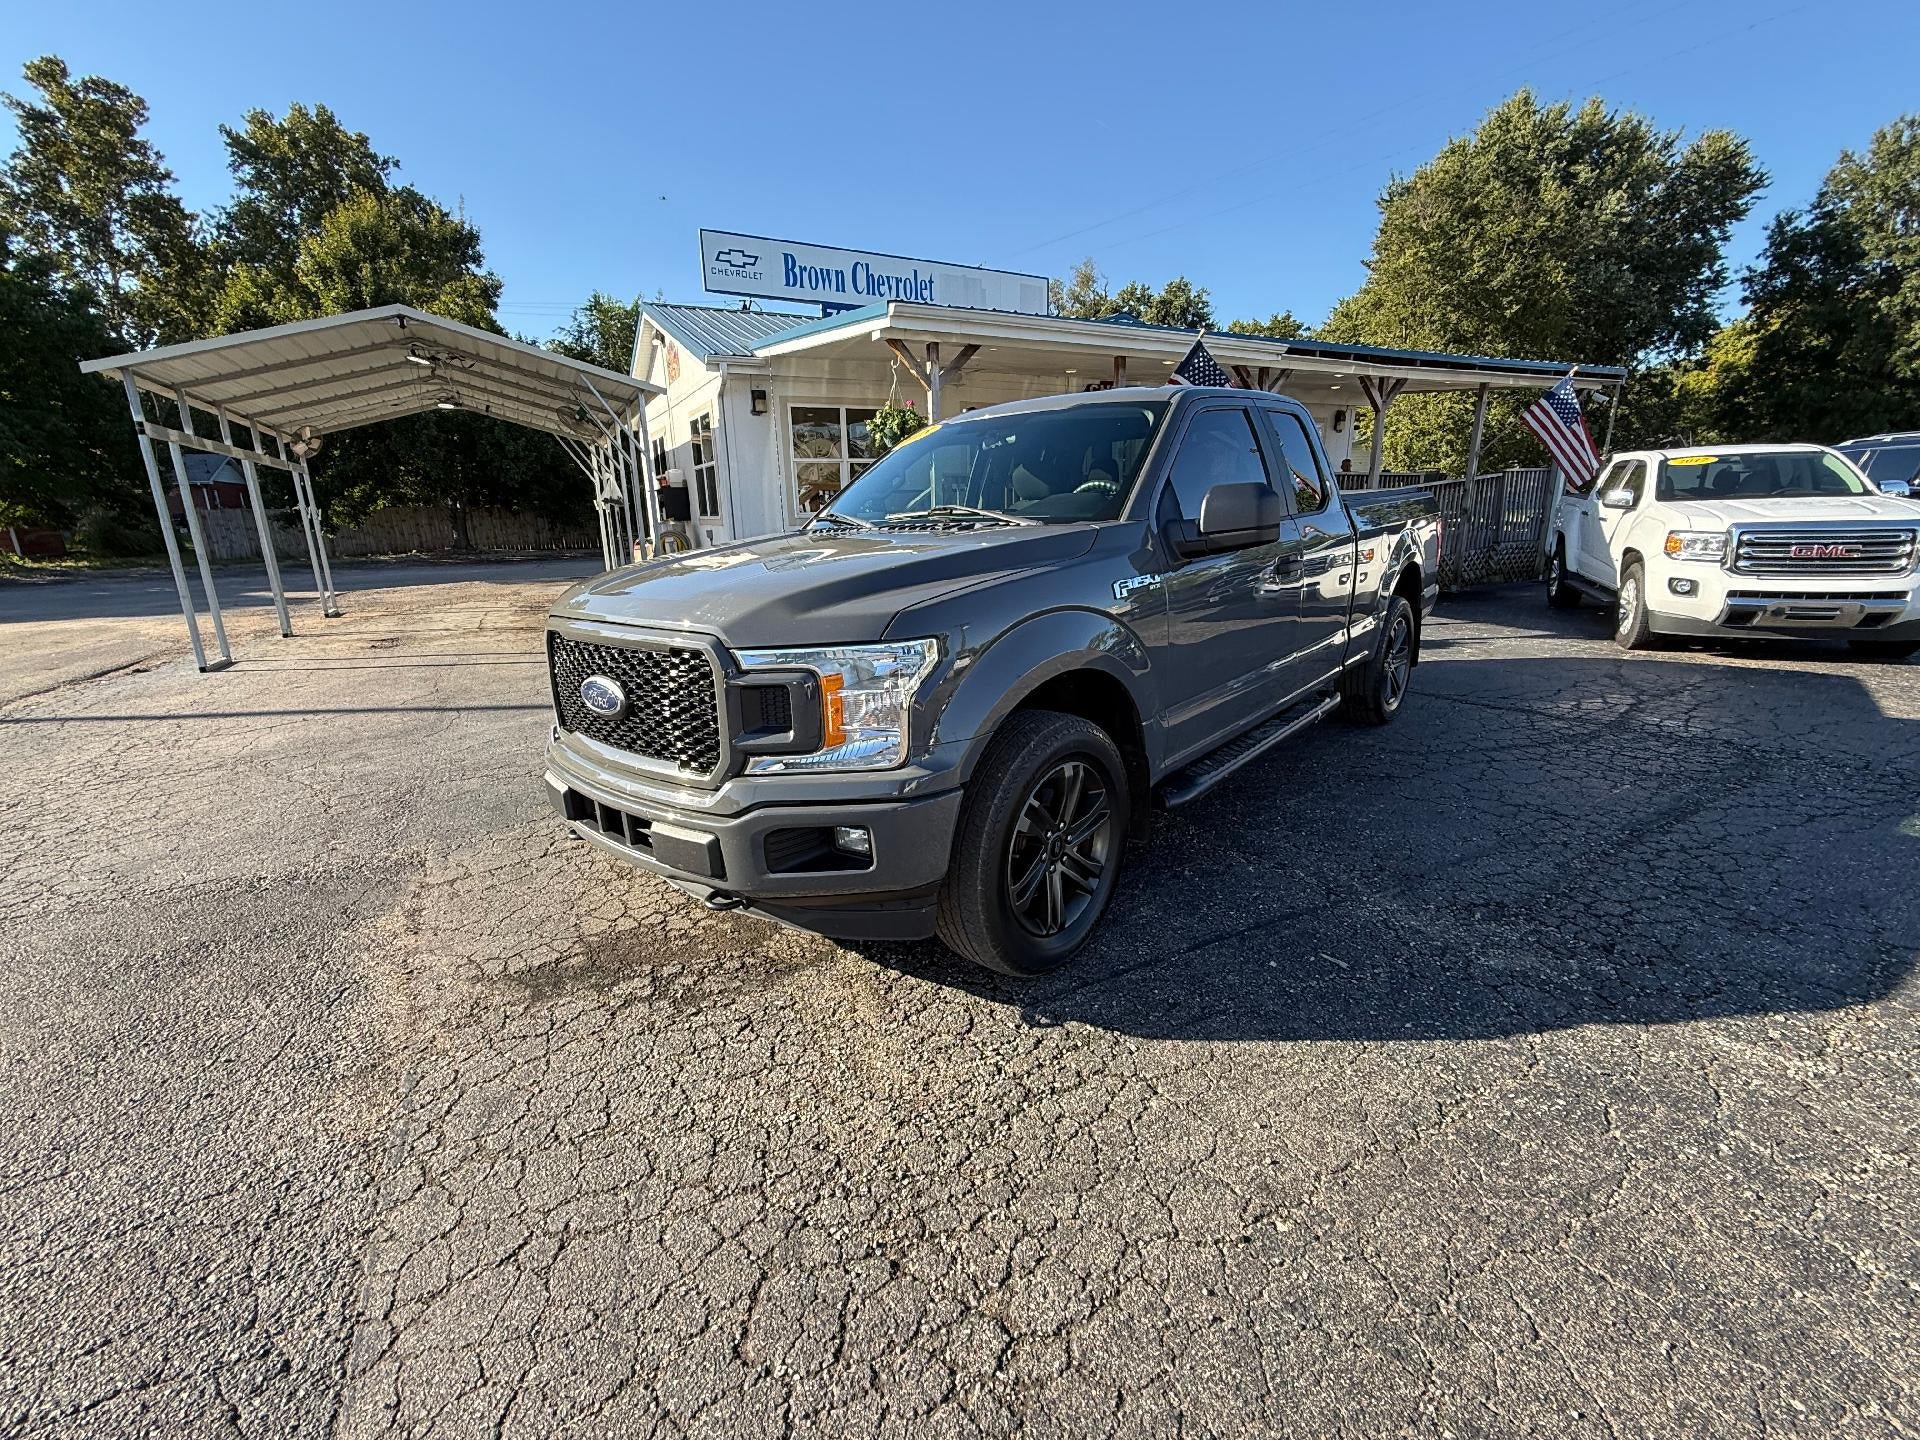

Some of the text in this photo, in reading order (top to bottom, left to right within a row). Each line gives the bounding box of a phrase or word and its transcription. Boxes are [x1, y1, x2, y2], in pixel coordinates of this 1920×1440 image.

[711, 266, 763, 280] CHEVROLET
[783, 253, 934, 302] Brown Chevrolet
[1791, 544, 1863, 558] GMC
